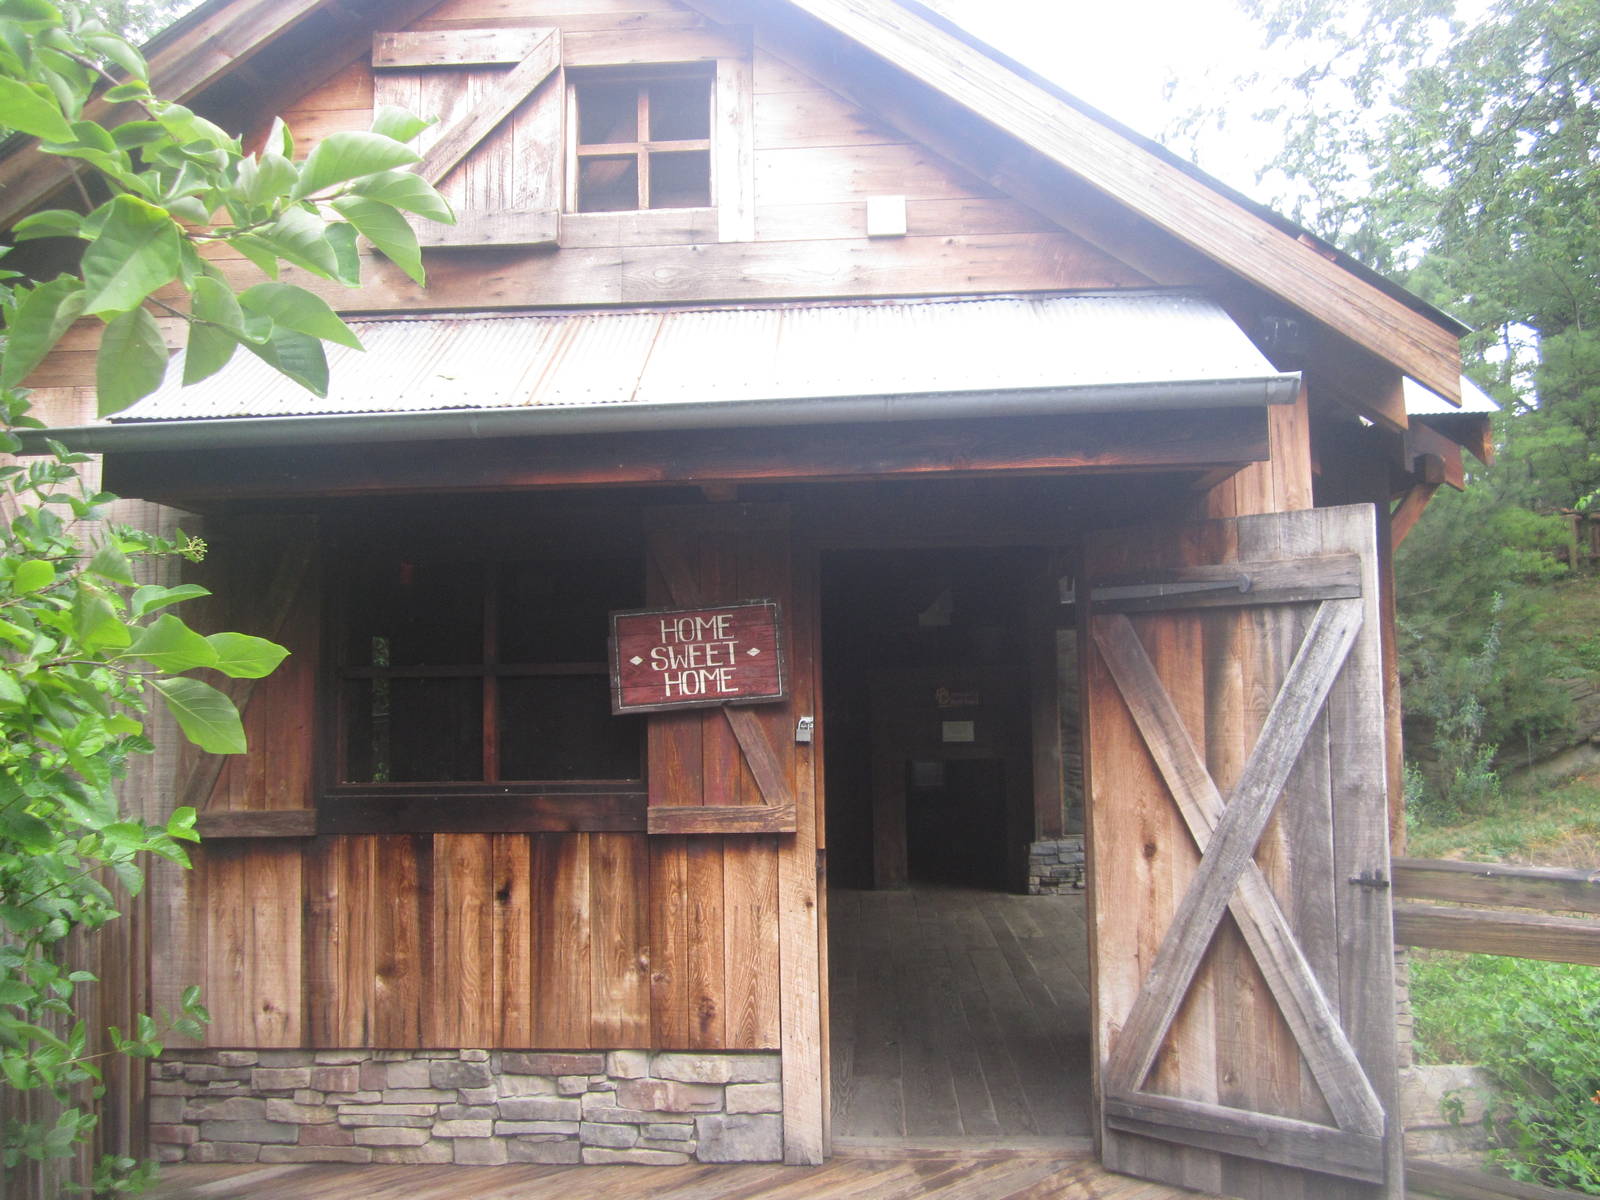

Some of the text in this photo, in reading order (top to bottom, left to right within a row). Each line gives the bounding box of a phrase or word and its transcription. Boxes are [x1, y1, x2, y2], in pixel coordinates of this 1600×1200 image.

[661, 614, 734, 643] HOME
[651, 641, 738, 671] SWEET
[665, 667, 738, 697] HOME
